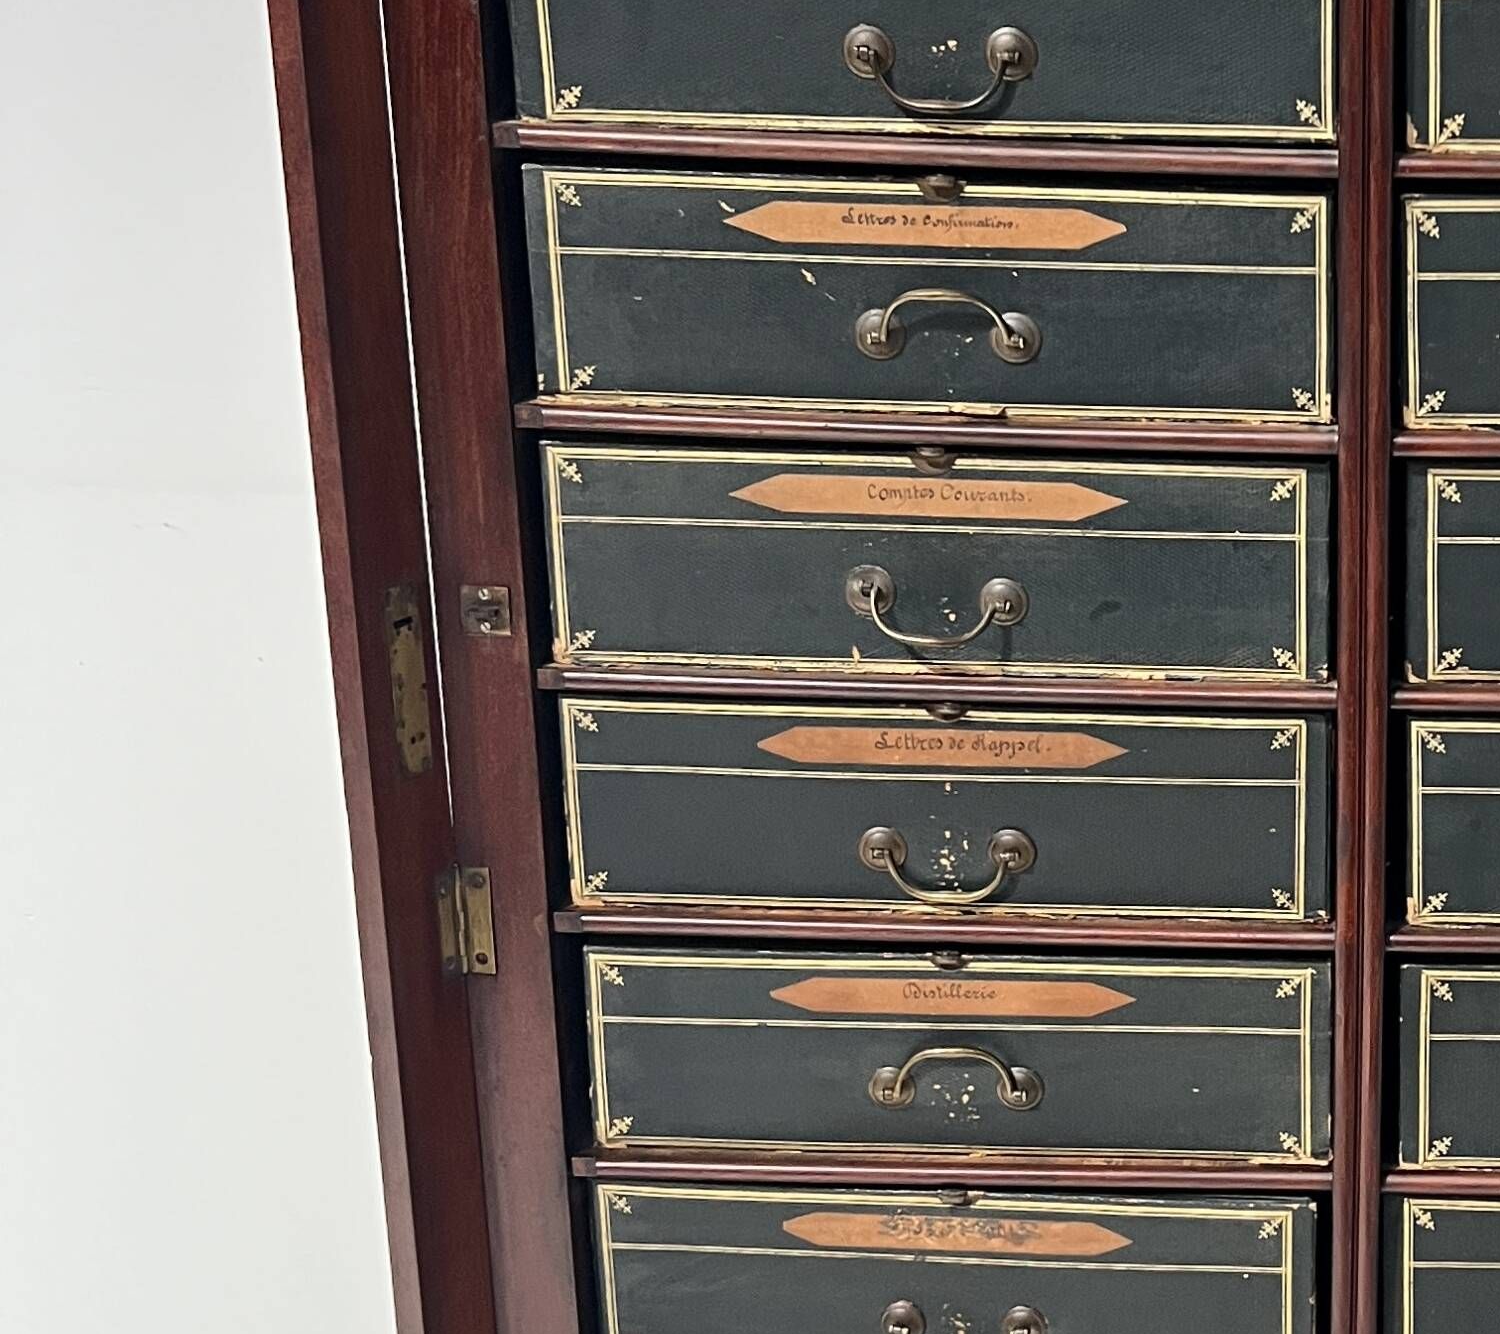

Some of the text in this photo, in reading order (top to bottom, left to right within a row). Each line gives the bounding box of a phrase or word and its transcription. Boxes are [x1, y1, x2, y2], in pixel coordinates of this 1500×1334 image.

[841, 206, 897, 226] Lettres
[901, 214, 917, 226] de
[867, 482, 935, 507] Comptes
[874, 730, 943, 751] Lettres
[948, 736, 965, 751] de
[902, 981, 999, 1000] Distillerie
